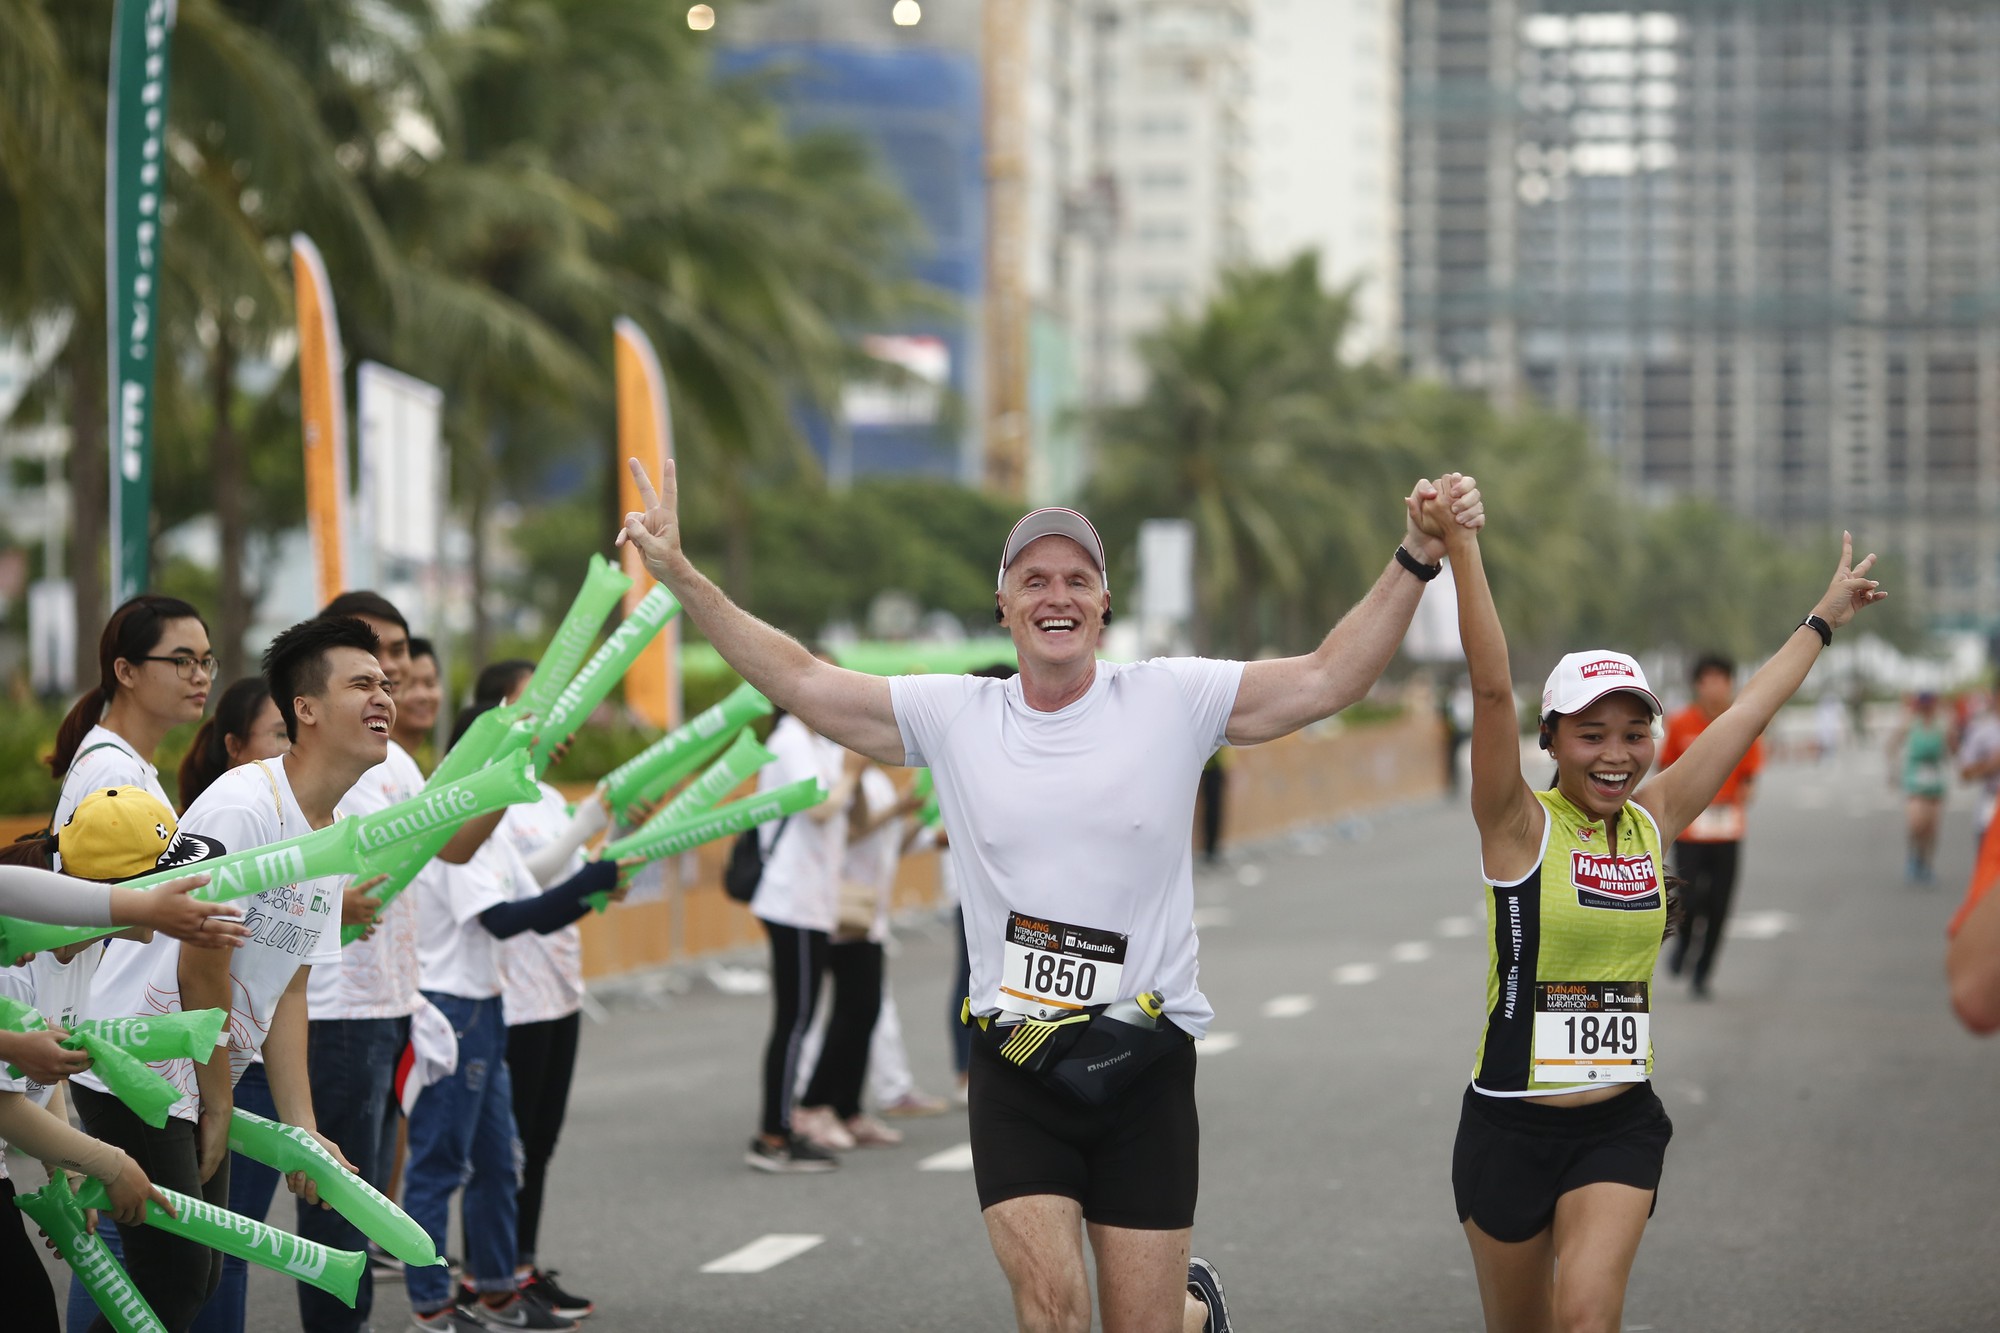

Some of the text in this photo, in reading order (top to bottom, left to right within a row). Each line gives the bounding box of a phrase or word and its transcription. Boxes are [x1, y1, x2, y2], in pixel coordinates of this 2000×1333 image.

[1584, 662, 1632, 674] HAMMER
[1577, 856, 1655, 881] HAMMER
[1600, 880, 1646, 891] NUTRITION
[1015, 917, 1049, 933] DANANG
[1013, 932, 1047, 947] MARATHON
[1014, 926, 1058, 942] INTERNATIONAL
[1076, 939, 1116, 954] Manulife
[1024, 952, 1097, 1001] 1850
[1547, 985, 1587, 994] DANANG
[1546, 1001, 1586, 1009] MARATHON
[1547, 994, 1598, 1002] INTERNATIONAL
[1615, 994, 1643, 1004] Manulife
[1564, 1015, 1638, 1055] 1849
[1097, 1050, 1132, 1070] NATHAN
[72, 1231, 162, 1333] anulife
